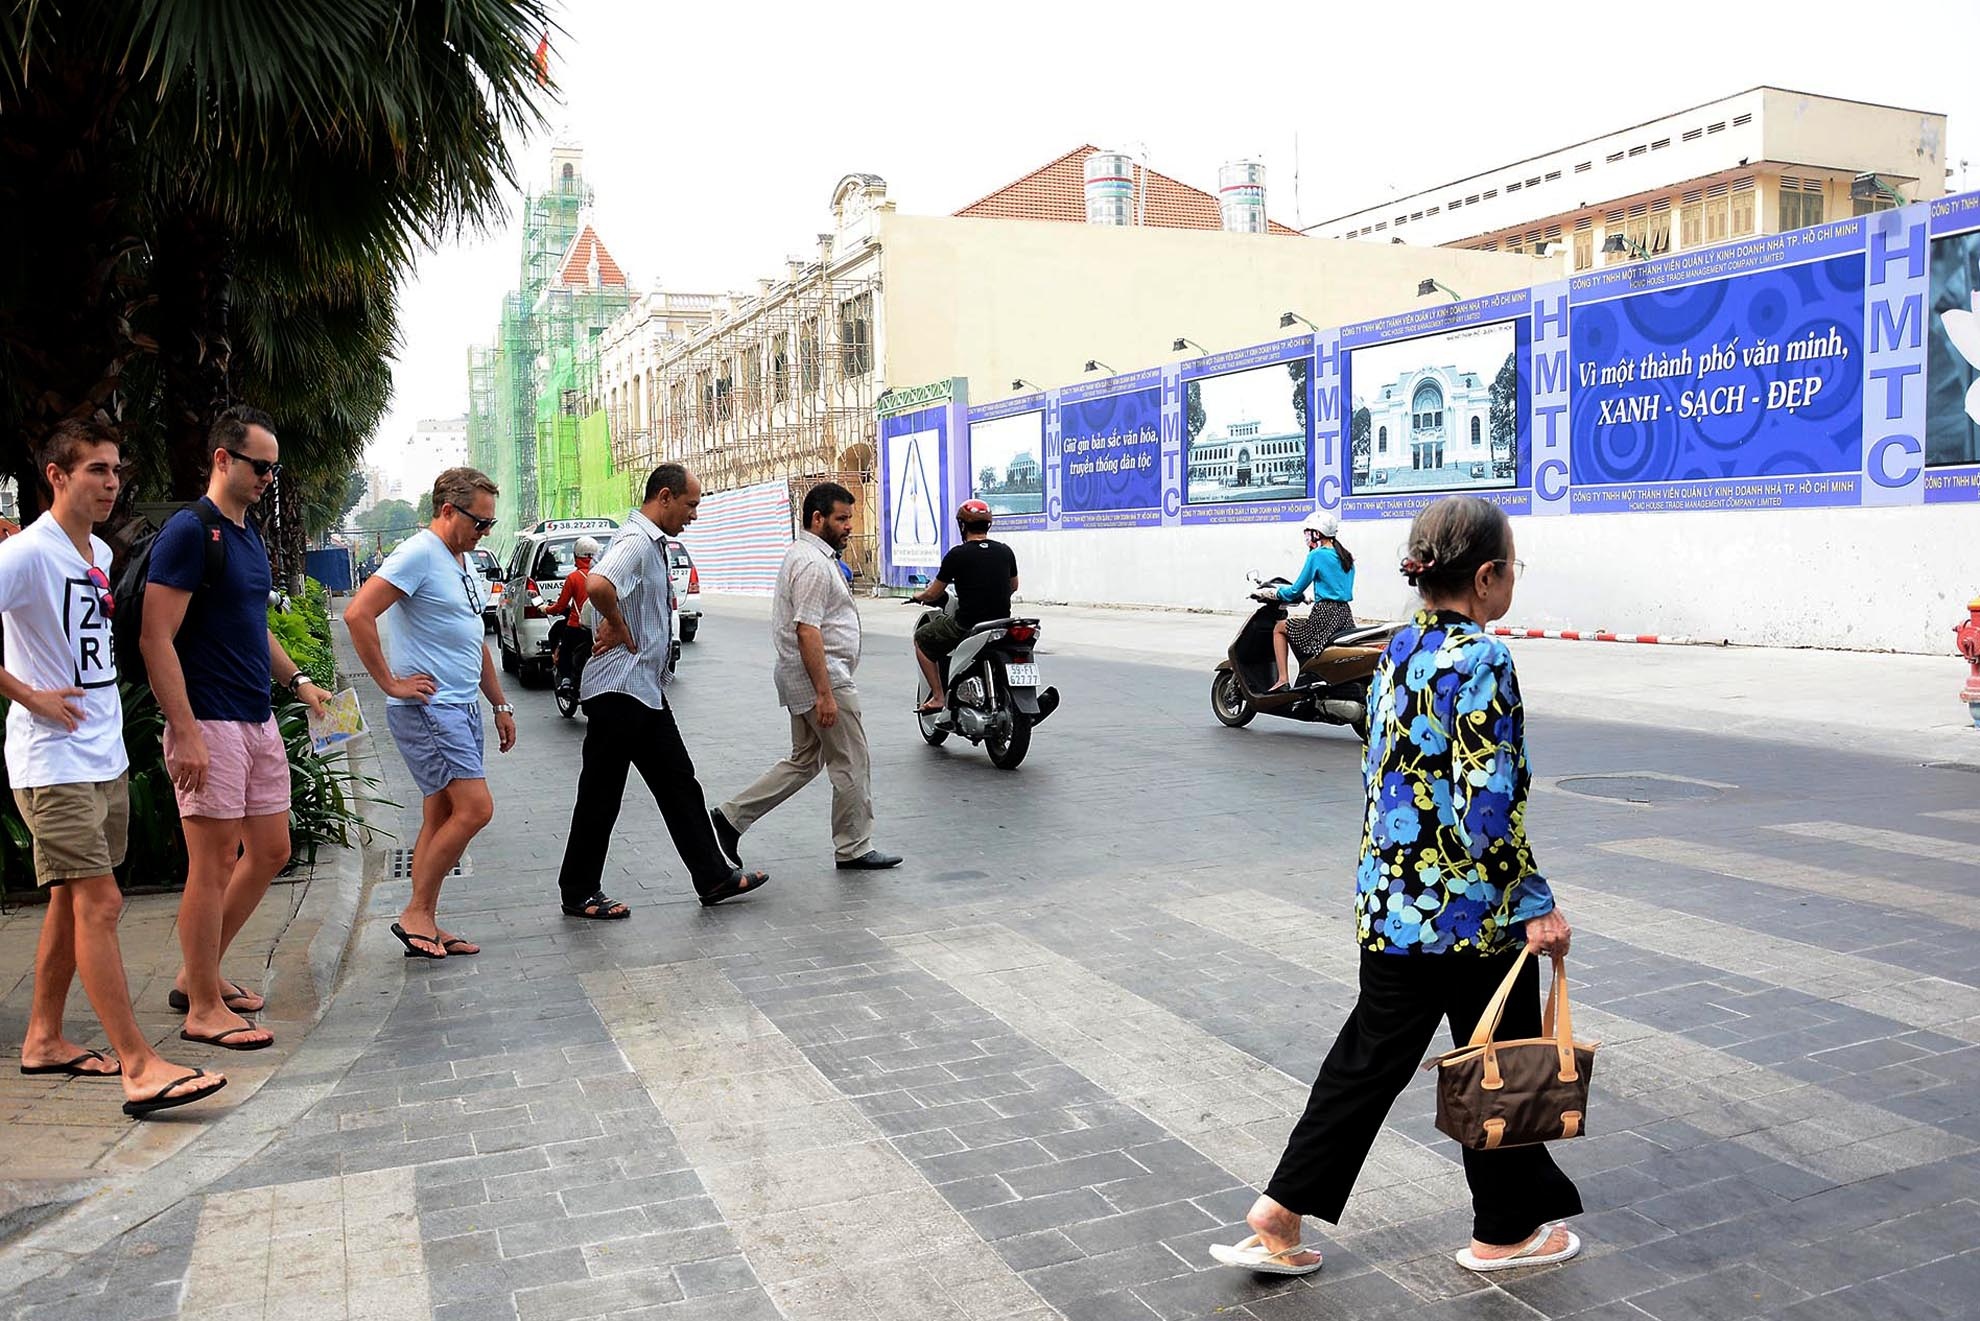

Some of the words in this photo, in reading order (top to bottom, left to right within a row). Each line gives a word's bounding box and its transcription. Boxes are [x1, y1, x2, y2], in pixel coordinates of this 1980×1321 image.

[1951, 199, 1959, 213] TY
[1961, 196, 1979, 211] TNHH
[1572, 278, 1592, 290] CÔNG
[1592, 277, 1601, 287] TY
[1603, 273, 1621, 284] TNHH
[1622, 269, 1637, 281] MỘT
[1638, 264, 1661, 276] THÀNH
[1663, 261, 1681, 273] VIÊN
[1682, 253, 1702, 269] QUẢN
[1704, 251, 1716, 266] LÝ
[1716, 249, 1735, 261] KINH
[1737, 244, 1765, 257] DOANH
[1767, 236, 1785, 252] NHÀ
[1787, 236, 1800, 247] TP.
[1802, 228, 1815, 243] HỒ
[1817, 227, 1833, 241] CHÍ
[1835, 223, 1858, 236] MINH
[1647, 278, 1665, 287] HOUSE
[1666, 274, 1685, 283] TRADE
[1685, 263, 1727, 279] MANAGEMENT
[1728, 258, 1759, 270] COMPANY
[1760, 252, 1785, 264] LIMITED
[1500, 294, 1511, 305] CHÍ
[1512, 292, 1527, 302] MINH
[1600, 357, 1635, 388] một
[1640, 348, 1693, 380] thành
[1697, 337, 1740, 379] phố
[1742, 338, 1779, 367] văn
[1785, 326, 1848, 361] minh,
[1867, 221, 1926, 488] HMTC
[1534, 295, 1568, 501] HMTC
[1597, 394, 1660, 426] XANH
[1679, 385, 1746, 423] SẠCH
[1767, 376, 1823, 414] ĐẸP
[1078, 436, 1090, 455] gìn
[1091, 432, 1106, 450] bản
[1107, 427, 1121, 448] sắc
[1123, 429, 1138, 446] văn
[1139, 426, 1159, 444] hóa,
[1316, 341, 1340, 510] HMTC
[1047, 398, 1060, 521] HMTC
[1163, 374, 1180, 517] HMTC
[1070, 455, 1094, 478] truyền
[1096, 453, 1118, 474] thống
[1120, 453, 1136, 470] dân
[1138, 451, 1152, 471] tộc
[1925, 475, 1942, 489] CÔNG
[1943, 477, 1951, 488] TY
[1953, 475, 1970, 488] TNHH
[1502, 493, 1512, 505] CHÍ
[1512, 495, 1527, 505] MINH
[1573, 491, 1591, 503] CÔNG
[1592, 492, 1601, 501] TY
[1603, 491, 1621, 501] TNHH
[1622, 489, 1636, 502] MỘT
[1638, 488, 1661, 500] THÀNH
[1663, 486, 1680, 499] VIÊN
[1681, 485, 1702, 498] QUẢN
[1704, 484, 1714, 497] LÝ
[1715, 486, 1733, 496] KINH
[1735, 484, 1763, 496] DOANH
[1765, 482, 1782, 495] NHÀ
[1784, 483, 1797, 494] TP.
[1800, 479, 1811, 494] HỒ
[1814, 480, 1829, 493] CHÍ
[1831, 481, 1854, 492] MINH
[1646, 501, 1664, 509] HOUSE
[1665, 500, 1684, 509] TRADE
[1685, 499, 1726, 508] MANAGEMENT
[1727, 497, 1757, 507] COMPANY
[1758, 497, 1782, 506] LIMITED
